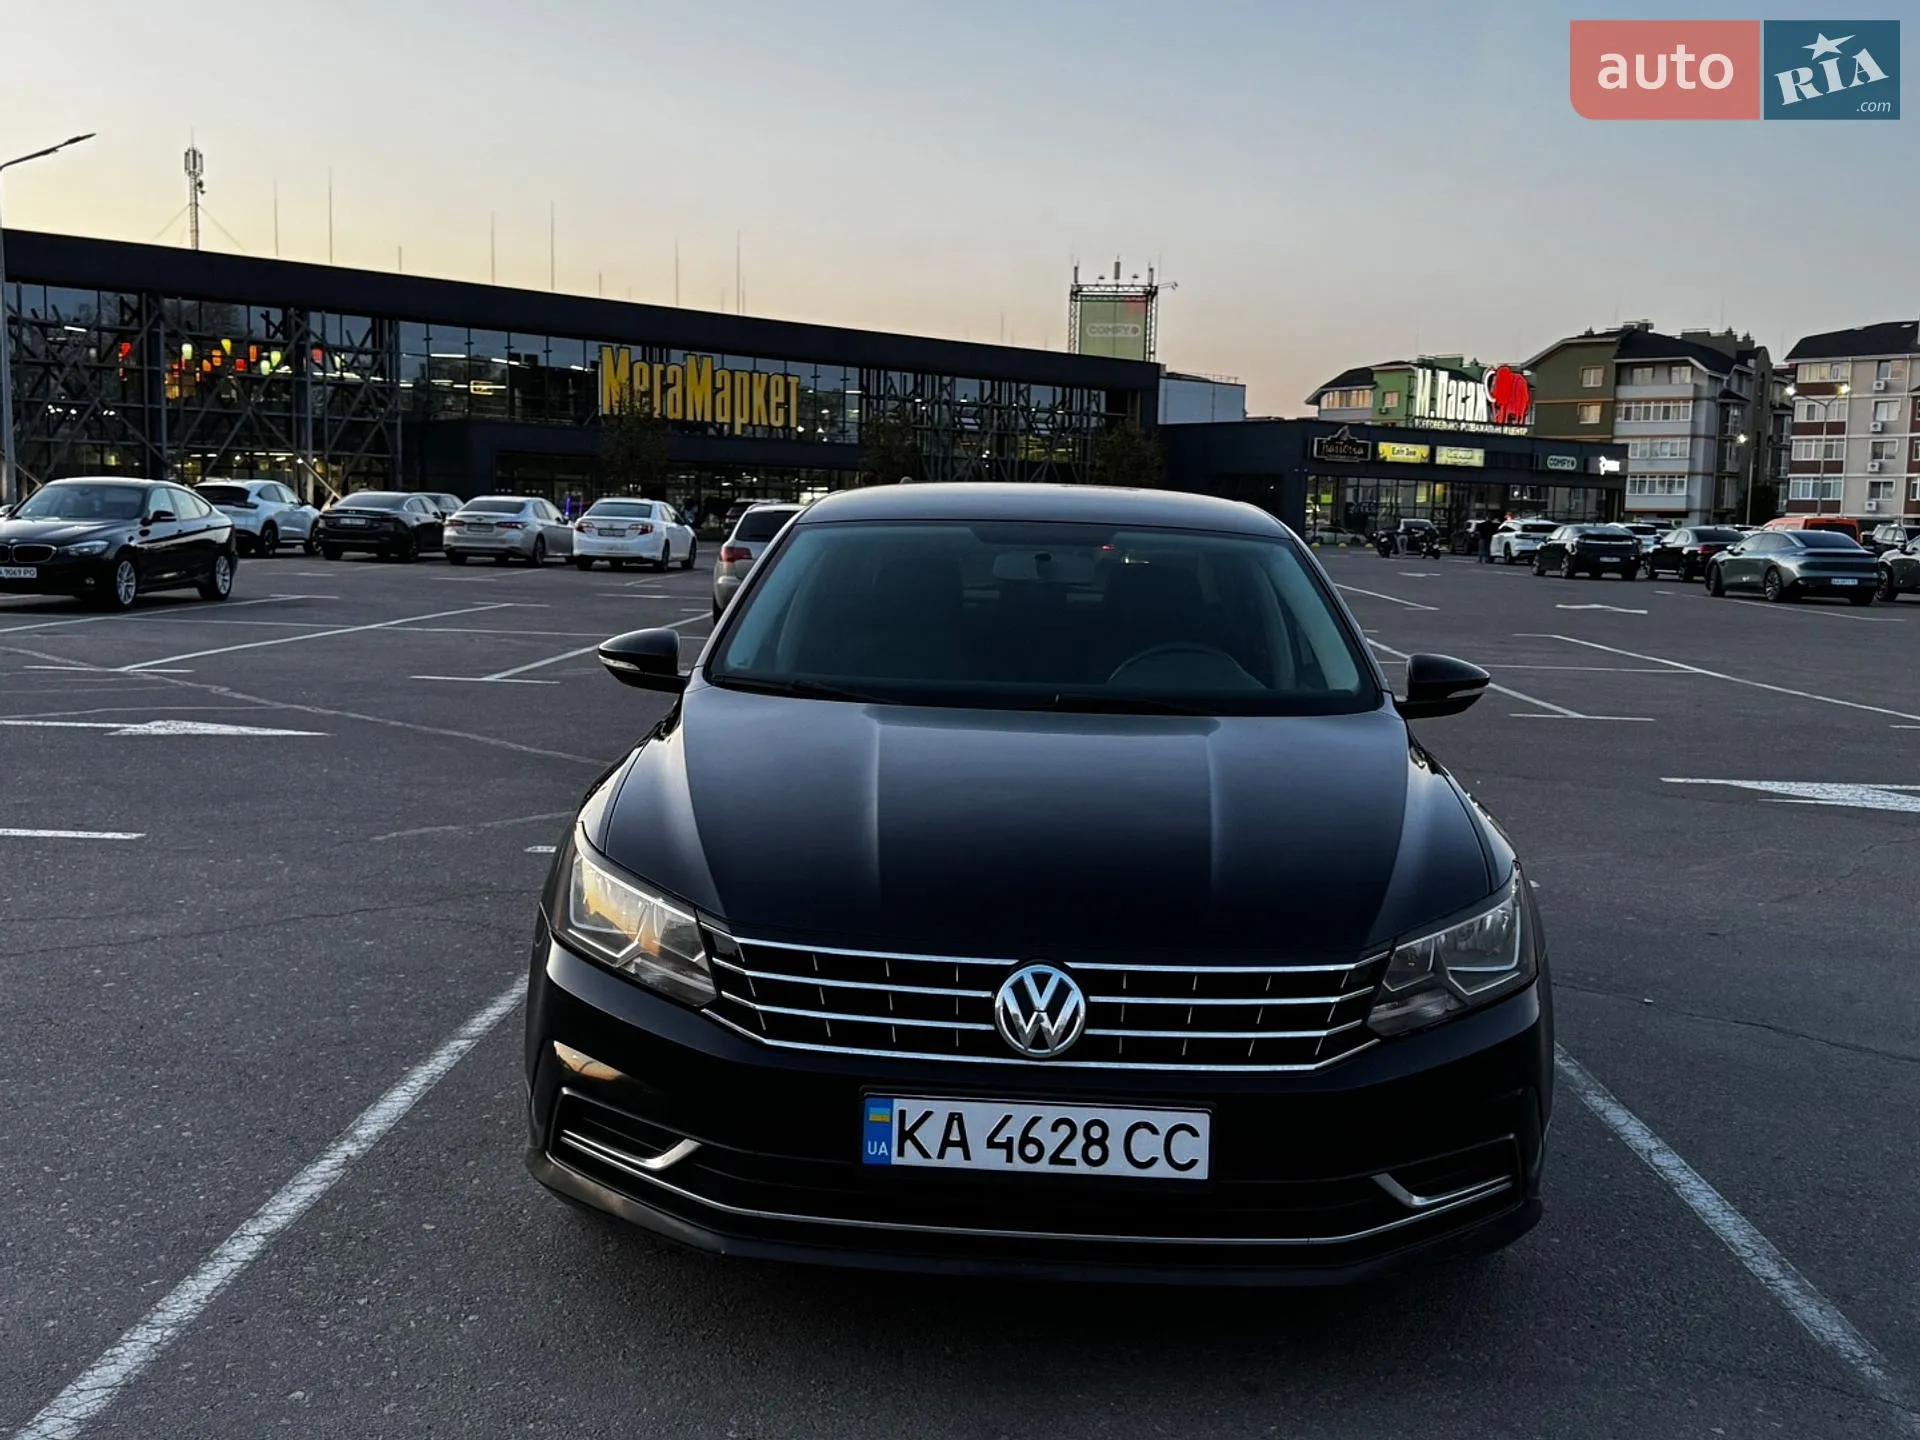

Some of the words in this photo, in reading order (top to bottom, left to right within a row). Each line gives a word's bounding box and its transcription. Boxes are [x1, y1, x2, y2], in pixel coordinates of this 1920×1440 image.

[1088, 325, 1130, 335] COMFY
[600, 346, 800, 435] МегаМаркет
[1549, 457, 1571, 468] COMFY
[896, 1108, 971, 1161] KA
[986, 1113, 1110, 1168] 4628
[1123, 1120, 1200, 1172] CC
[867, 1141, 889, 1157] UA
